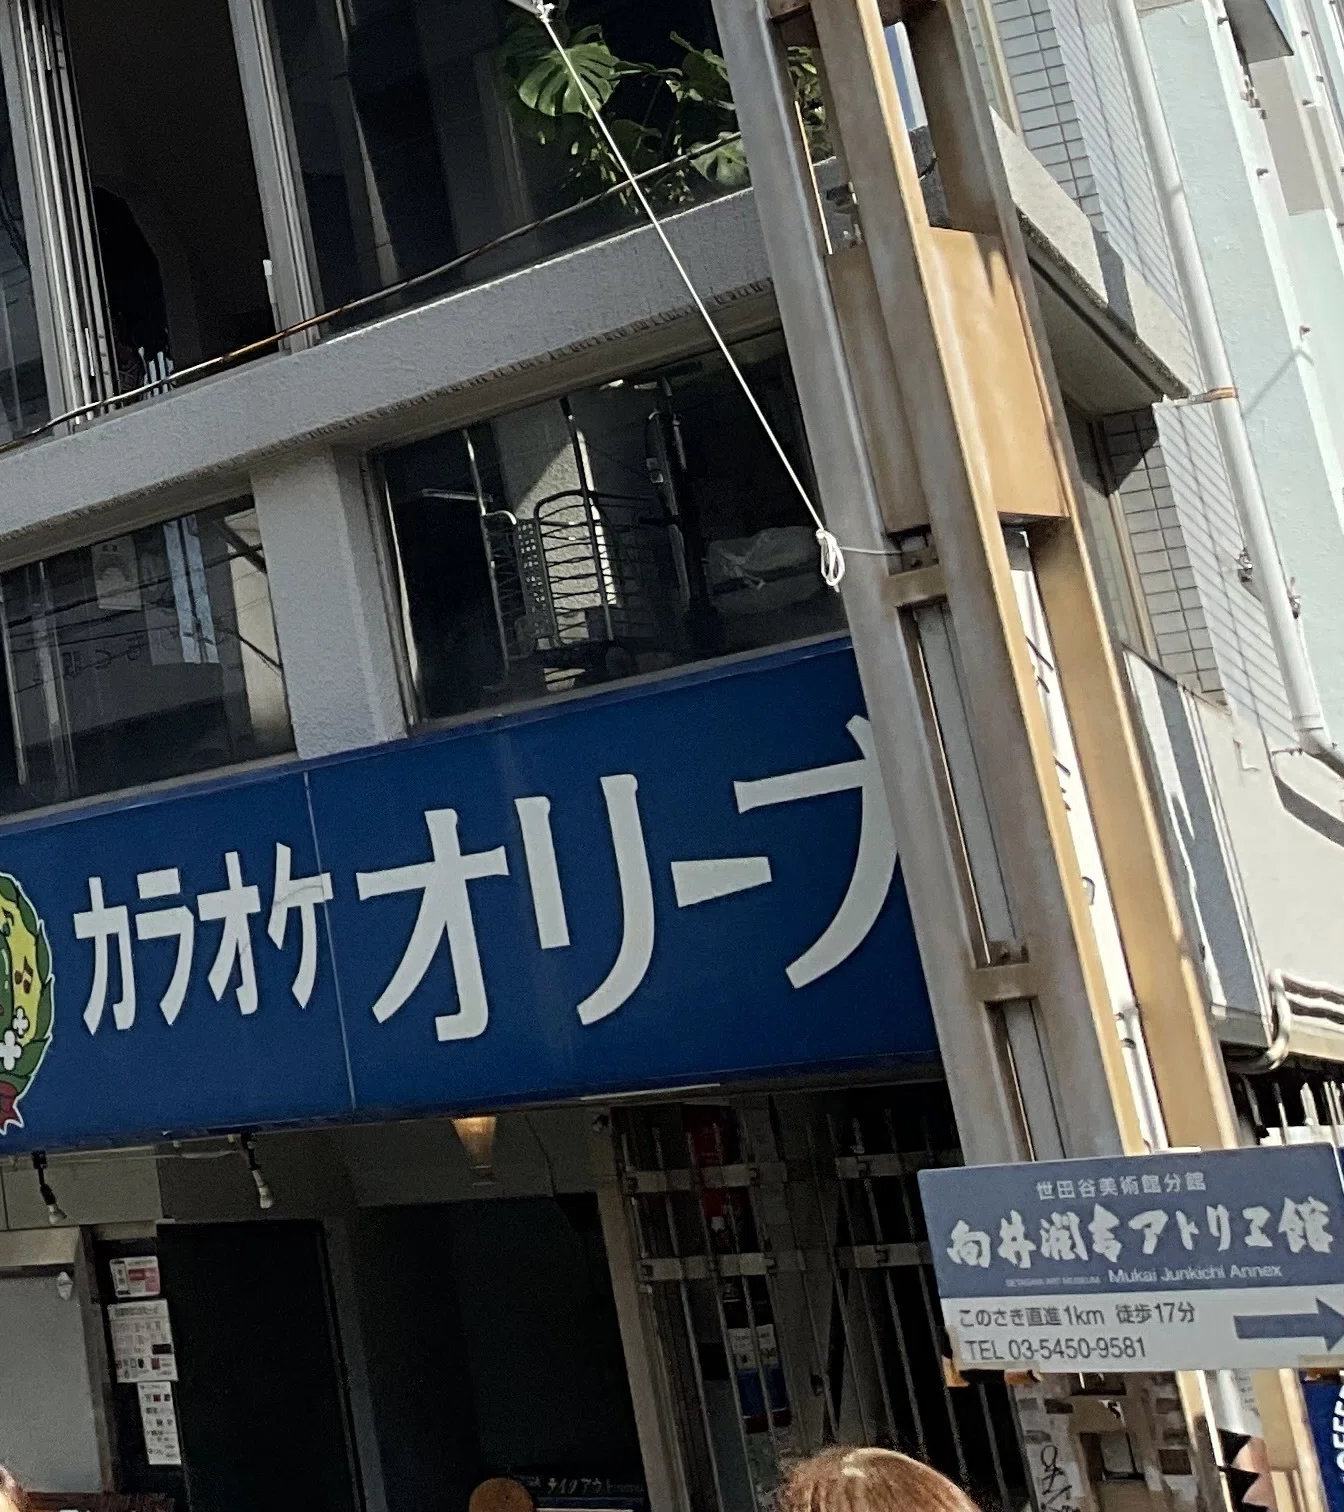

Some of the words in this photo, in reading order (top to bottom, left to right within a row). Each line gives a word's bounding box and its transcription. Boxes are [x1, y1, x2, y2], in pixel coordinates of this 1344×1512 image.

[73, 841, 333, 1035] カラオケ
[1037, 1171, 1206, 1201] 世田谷美術館分館
[1108, 1269, 1157, 1284] Mukai
[1160, 1264, 1226, 1282] Junkichi
[1230, 1264, 1283, 1279] Annex
[1115, 1302, 1196, 1325] 徒歩17分
[964, 1339, 1005, 1361] TEL
[1008, 1336, 1146, 1361] 03-5450-9581
